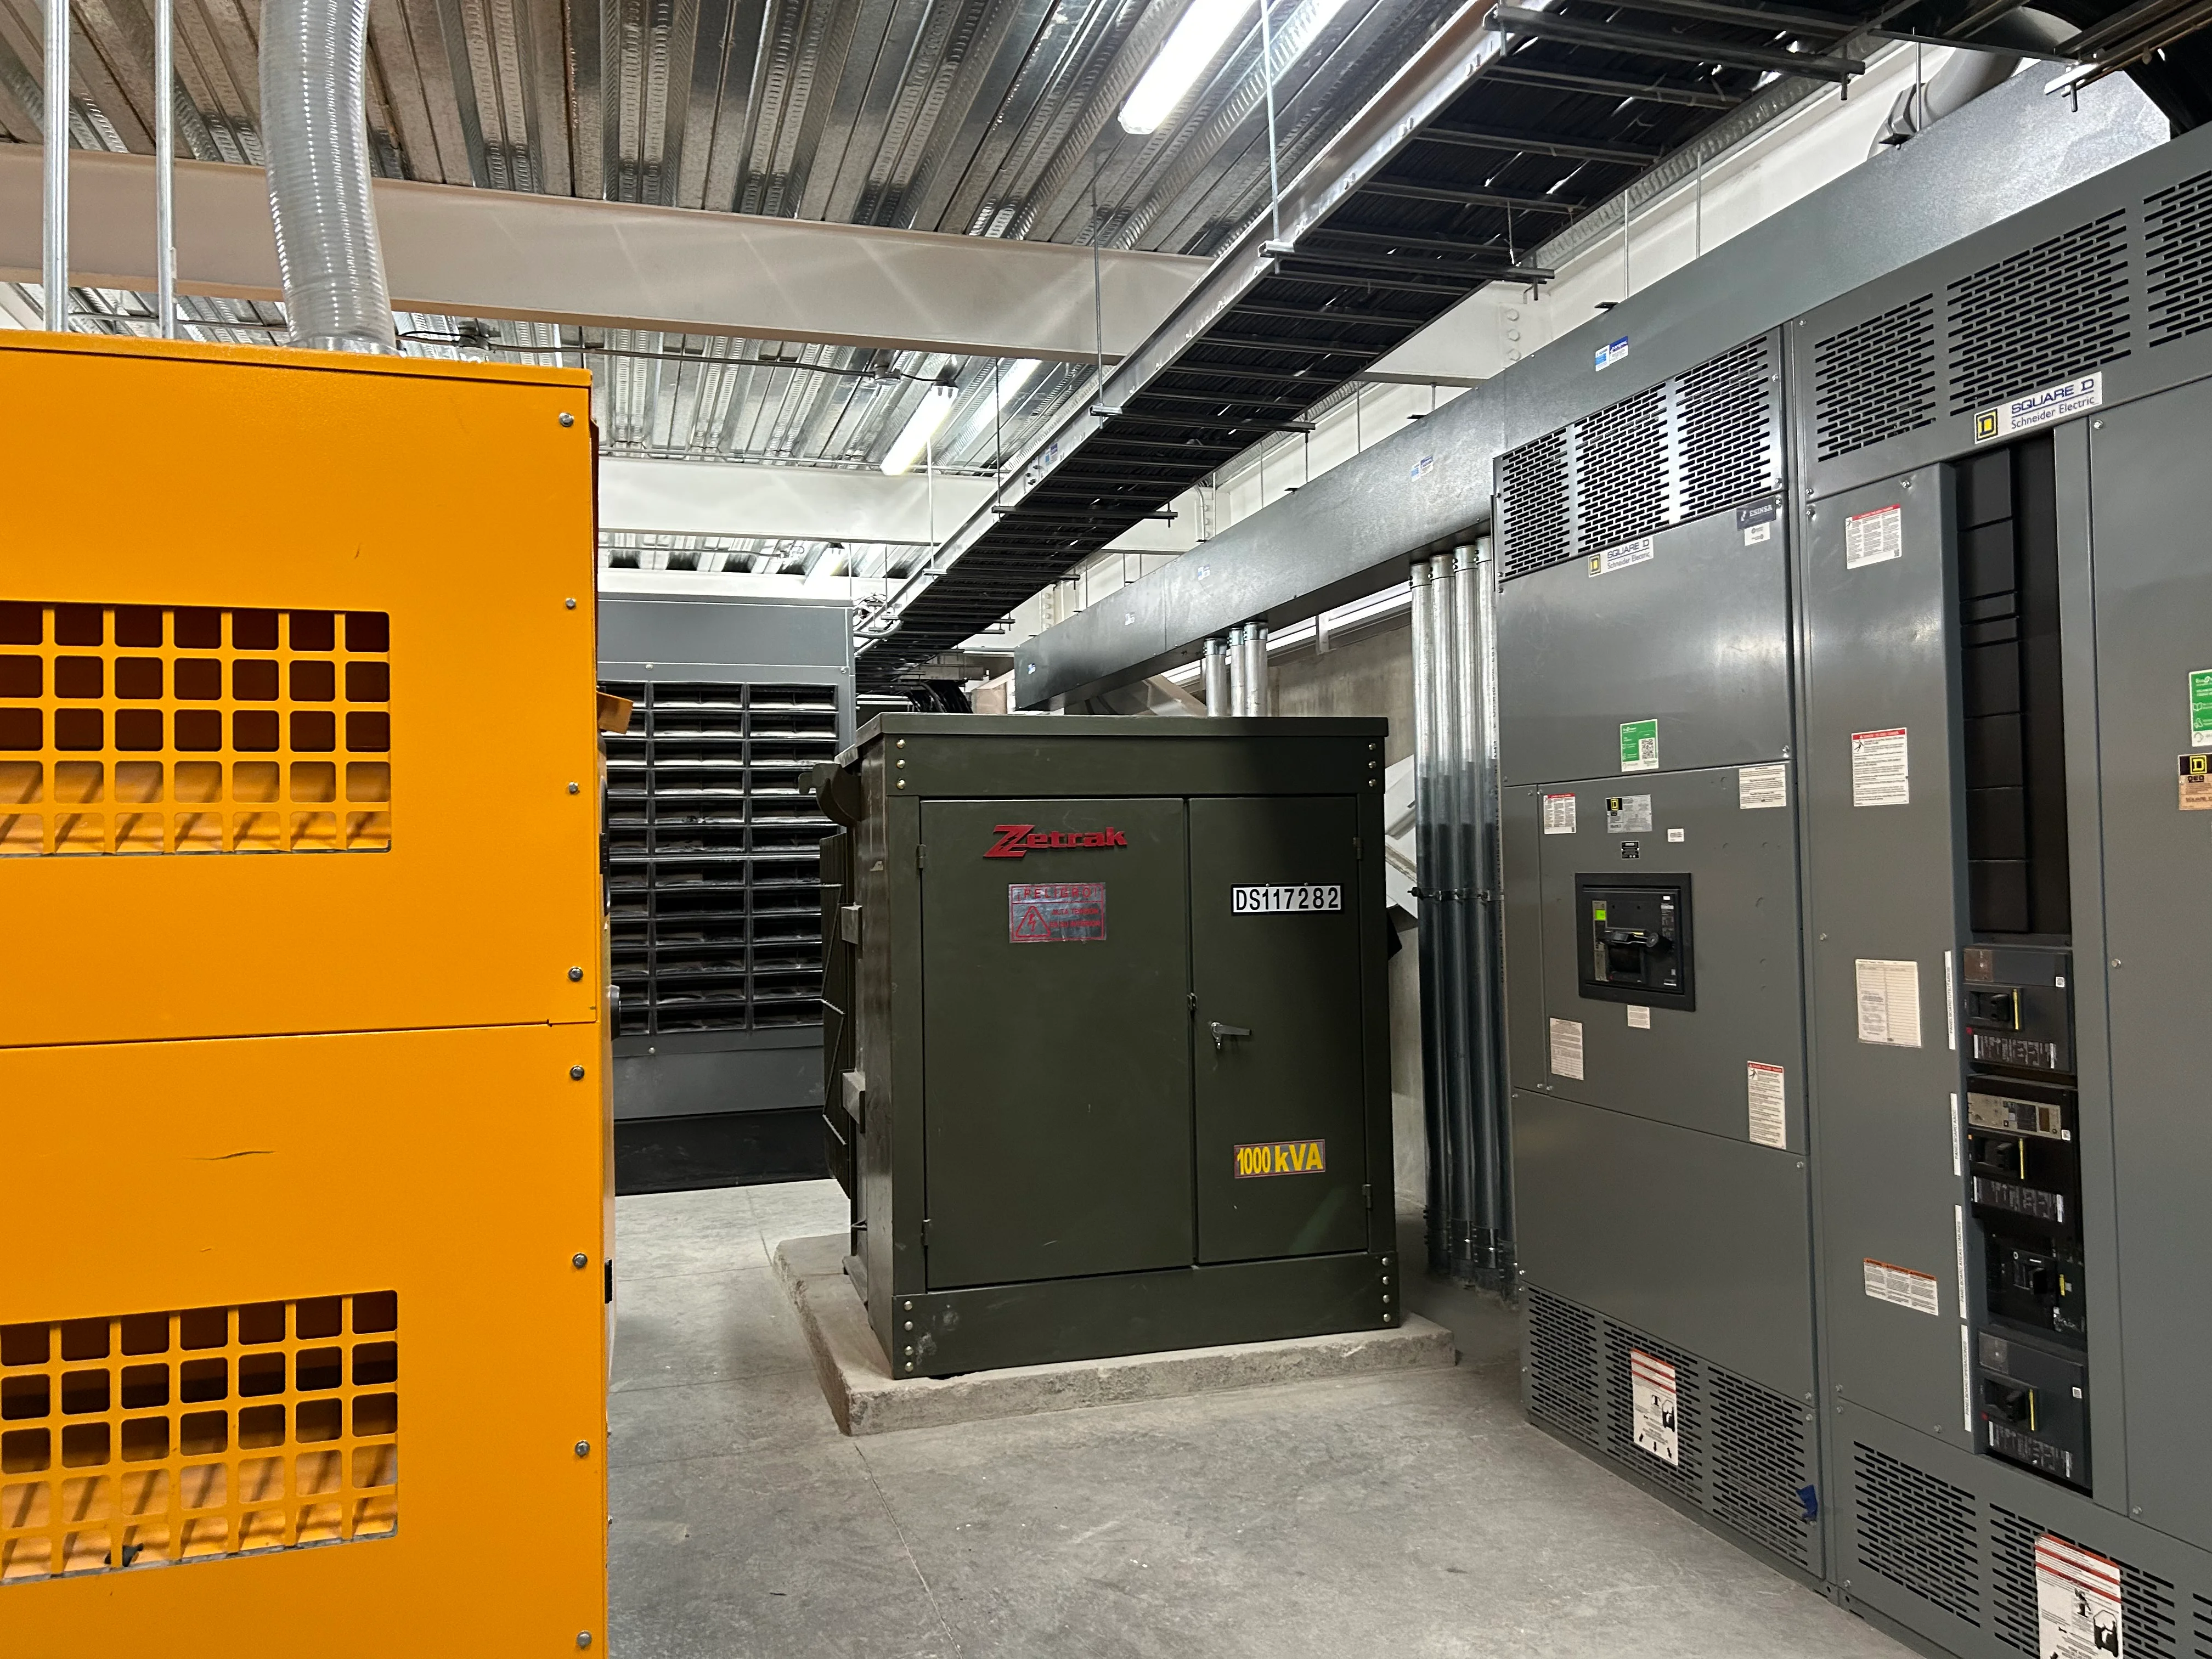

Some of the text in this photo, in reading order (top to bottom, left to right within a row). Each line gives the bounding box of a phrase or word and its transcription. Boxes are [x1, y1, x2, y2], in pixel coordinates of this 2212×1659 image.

[2011, 378, 2094, 414] SQUARE D
[2011, 396, 2095, 430] Schneider Electric
[1607, 539, 1650, 558] SQUARE D
[983, 824, 1128, 858] Zetrak
[1236, 887, 1339, 911] DS117282
[1237, 1143, 1324, 1175] 1000 kVA
